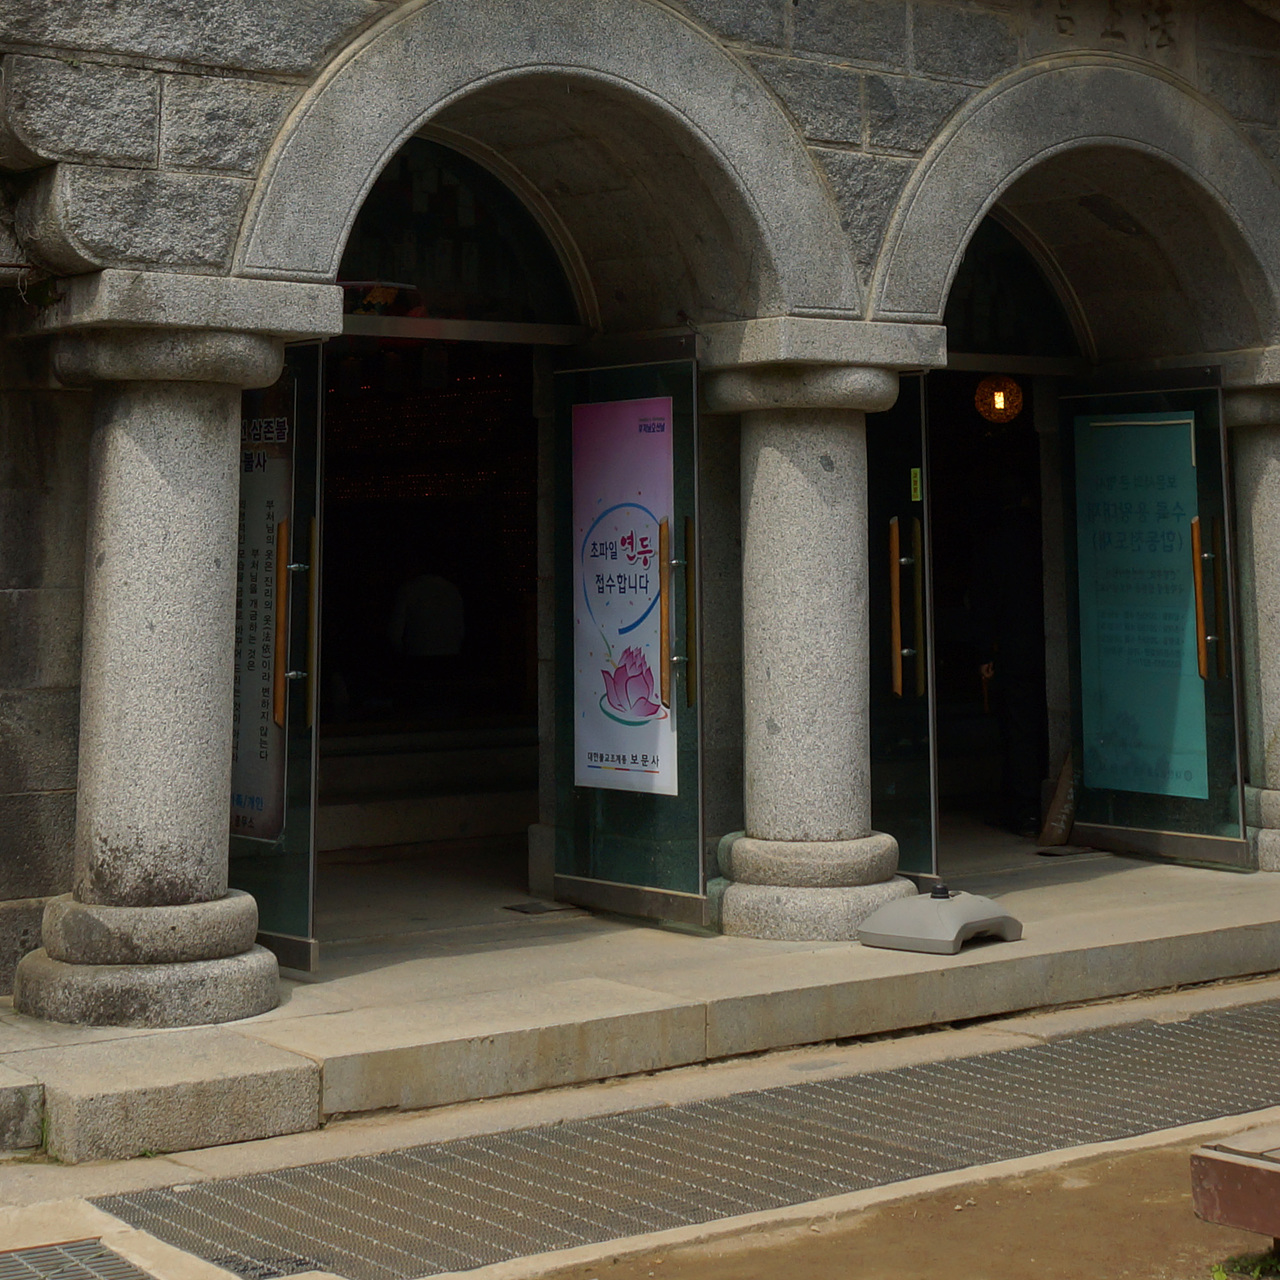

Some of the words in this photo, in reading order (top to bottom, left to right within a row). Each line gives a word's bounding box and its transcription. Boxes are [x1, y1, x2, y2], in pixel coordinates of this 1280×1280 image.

[590, 541, 618, 560] 초파일
[621, 530, 654, 567] 연등
[595, 573, 650, 594] 접수합니다
[630, 754, 660, 768] 보문사
